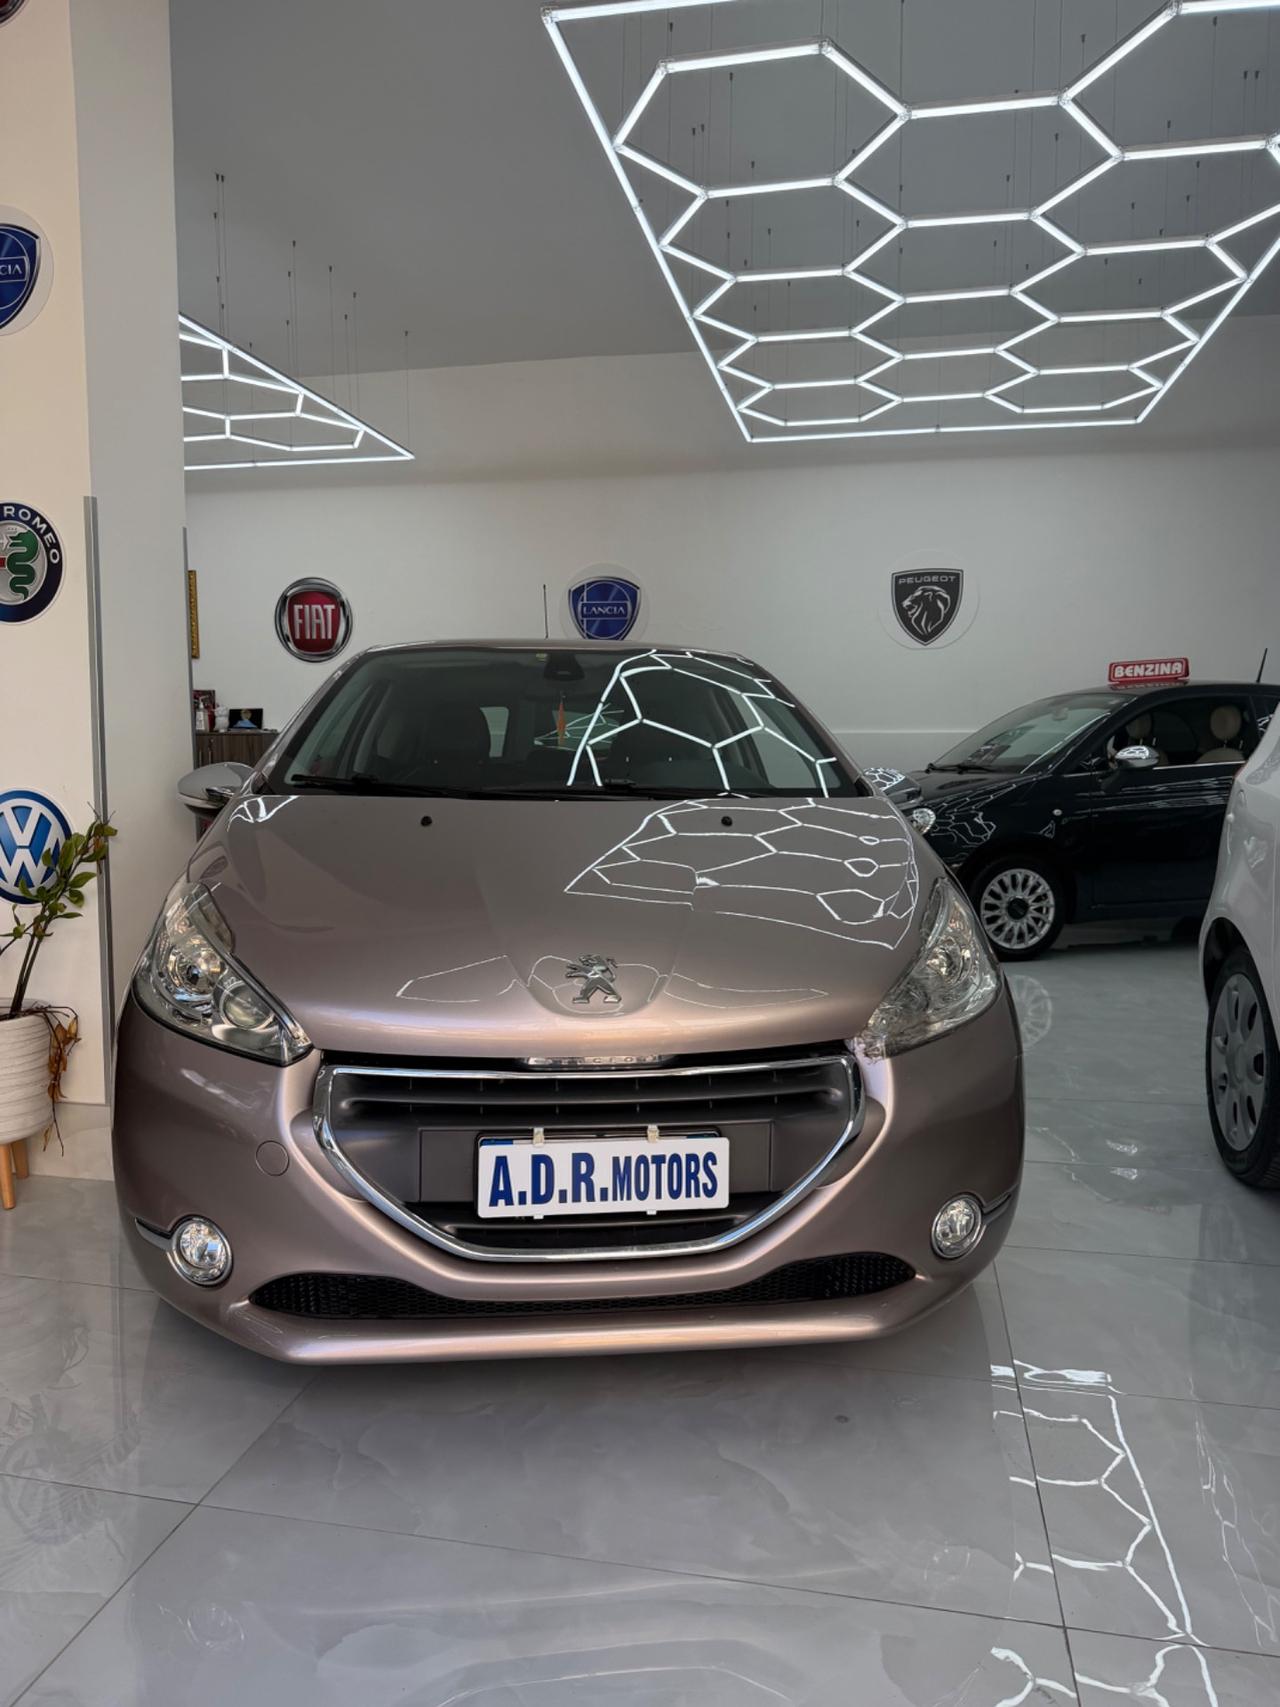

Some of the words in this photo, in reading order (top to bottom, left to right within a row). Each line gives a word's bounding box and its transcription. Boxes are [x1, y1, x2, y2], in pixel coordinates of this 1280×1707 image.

[3, 505, 60, 564] ROMEO
[898, 575, 956, 584] PEUGEOT
[583, 606, 625, 615] LANCIA
[293, 604, 336, 640] FIAT
[1114, 661, 1182, 678] BENZINA
